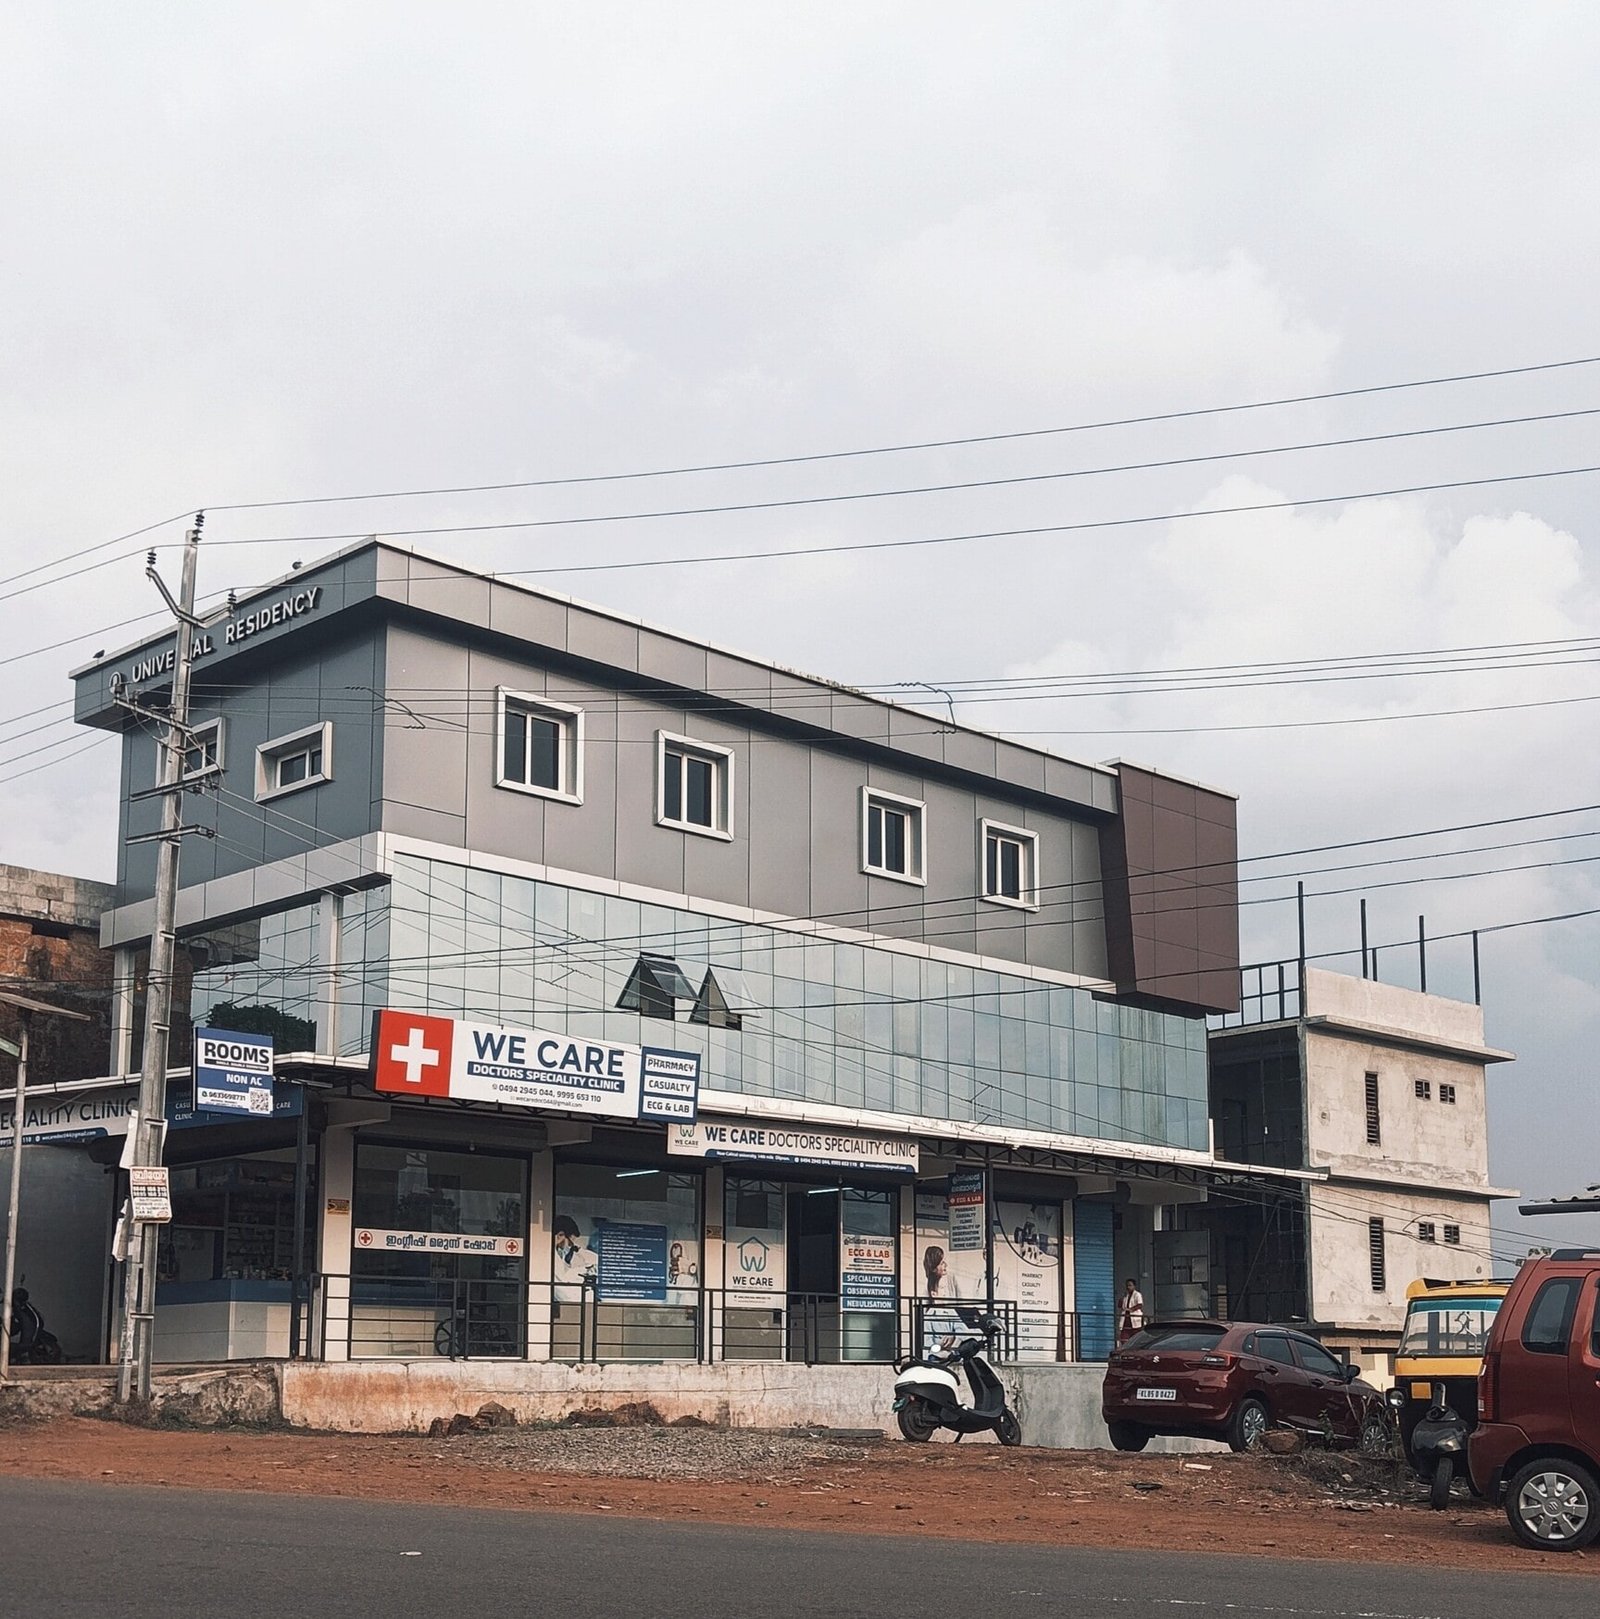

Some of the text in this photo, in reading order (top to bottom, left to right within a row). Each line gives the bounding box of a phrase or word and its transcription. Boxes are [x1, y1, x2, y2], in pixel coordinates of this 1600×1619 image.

[132, 586, 320, 683] UNIVEAL RESIDENCY
[204, 1042, 270, 1064] ROOMS
[473, 1031, 624, 1077] WE CARE
[647, 1058, 695, 1073] PHARMACY
[226, 1073, 263, 1086] NON AC
[473, 1064, 620, 1091] DOCTORS SPECIALITY CLINIC
[499, 1085, 518, 1093] 0494
[648, 1080, 691, 1093] CASUALTY
[80, 1097, 138, 1121] CLINIC
[646, 1100, 690, 1114] ECG & LAB
[705, 1126, 916, 1158] WE CARE DOCTORS SPECIALITY CLINIC
[848, 1248, 890, 1258] ECG & LAB
[732, 1276, 774, 1286] WE CARE
[882, 1276, 892, 1284] OP
[847, 1300, 892, 1308] NEBULISATION
